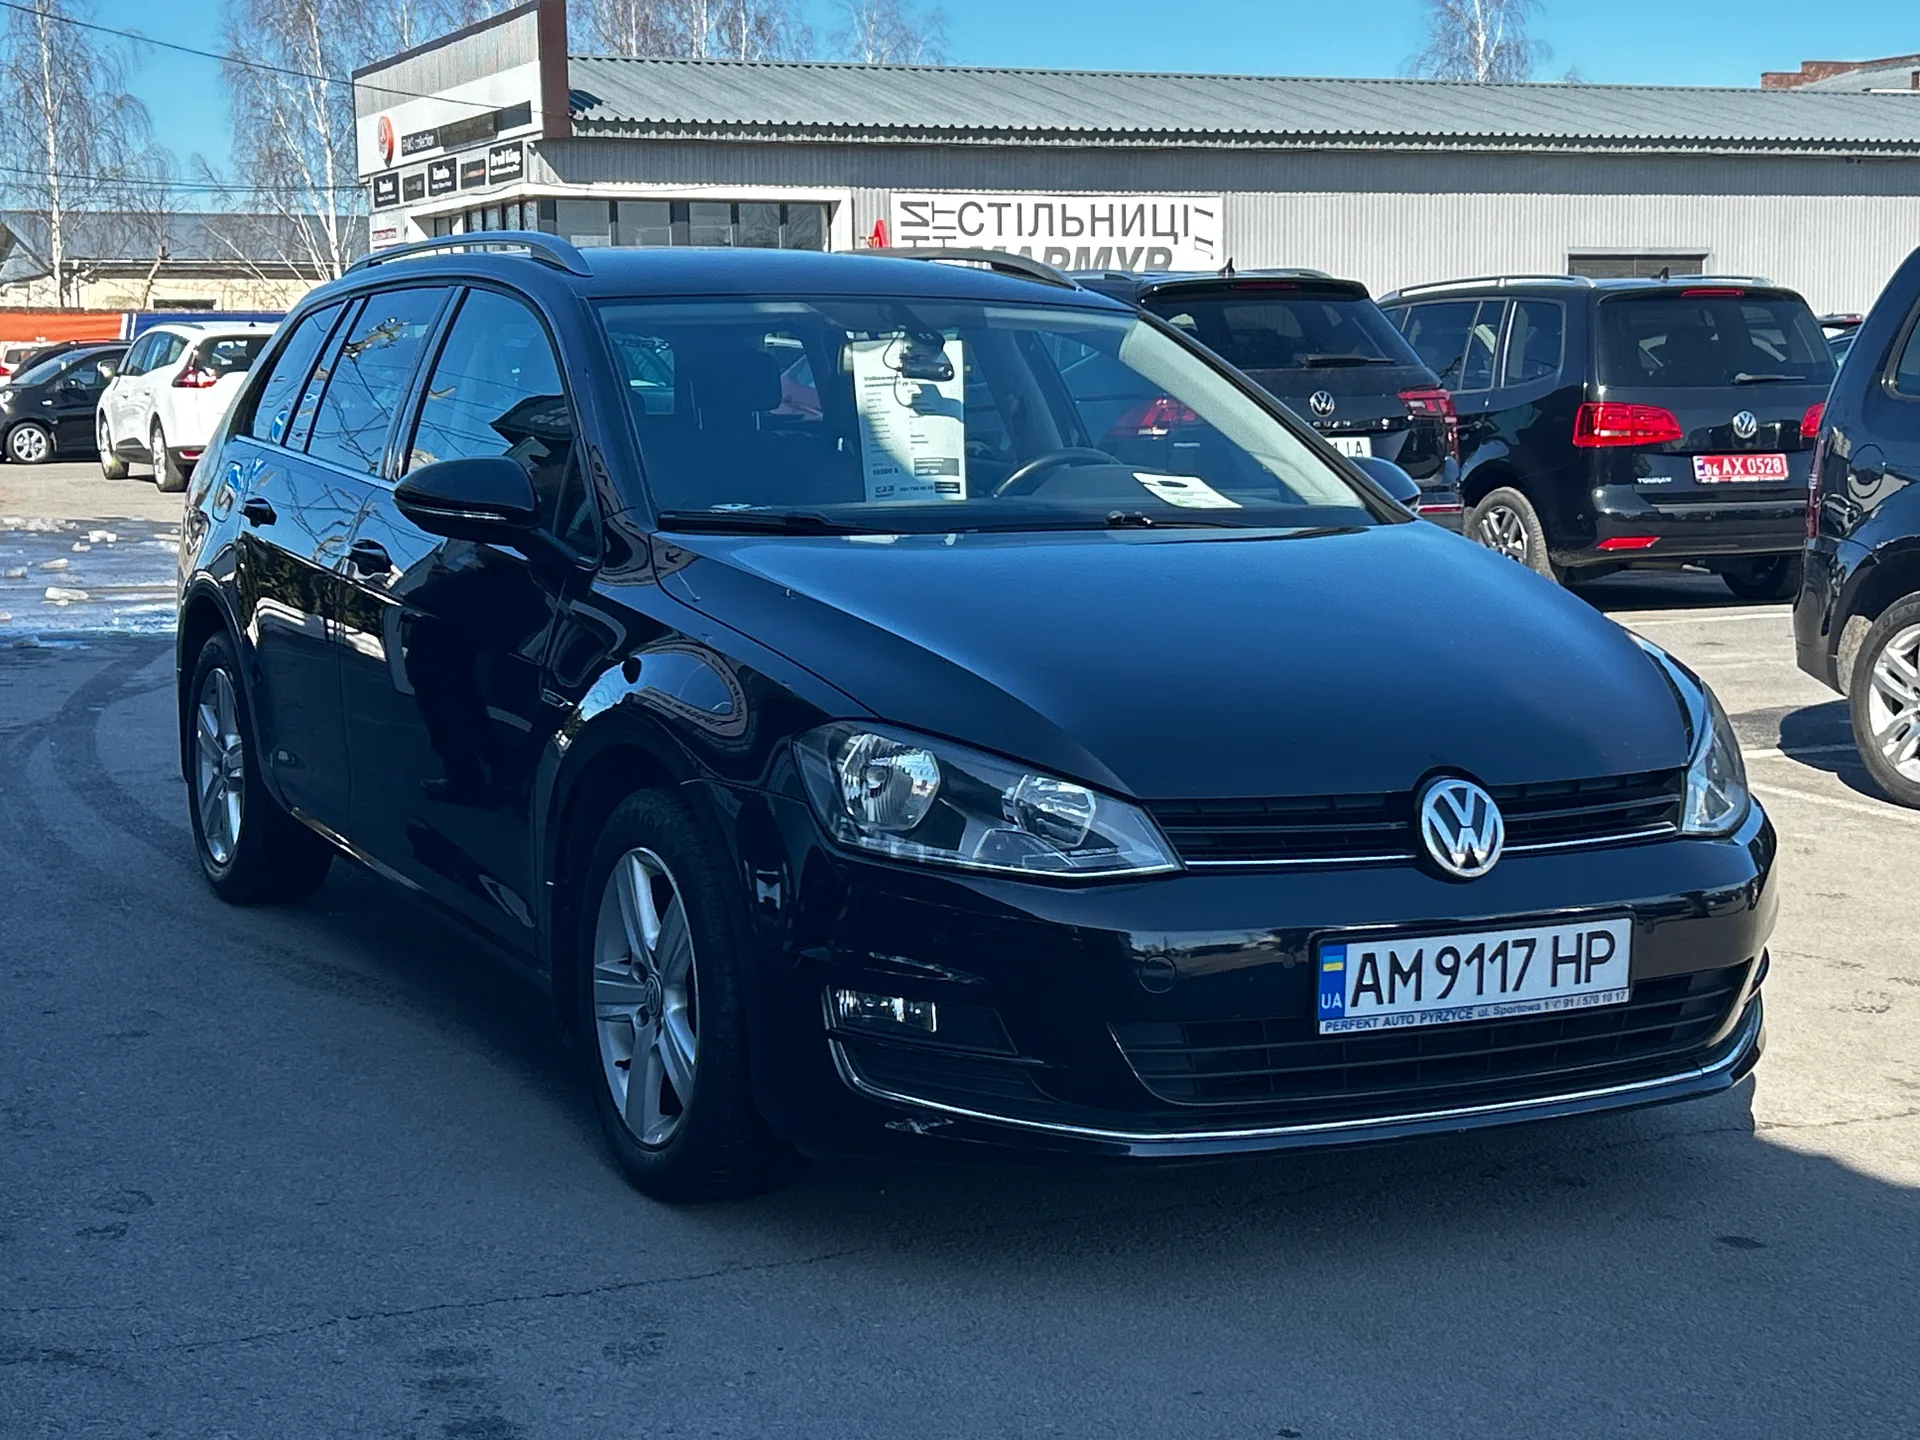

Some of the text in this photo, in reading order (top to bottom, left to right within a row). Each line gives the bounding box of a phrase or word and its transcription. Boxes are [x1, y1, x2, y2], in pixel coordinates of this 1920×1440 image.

[957, 201, 1189, 245] СТІЛЬНИЦІ
[1722, 458, 1745, 475] AX
[1747, 458, 1782, 474] 0528
[1350, 930, 1616, 1007] AM 9117 HP
[1320, 992, 1343, 1009] UA
[1325, 1017, 1379, 1032] PERFEKT
[1382, 1014, 1415, 1027] AUTO
[1419, 1007, 1473, 1024] PYRZYCE
[1493, 1002, 1541, 1016] Sportowa
